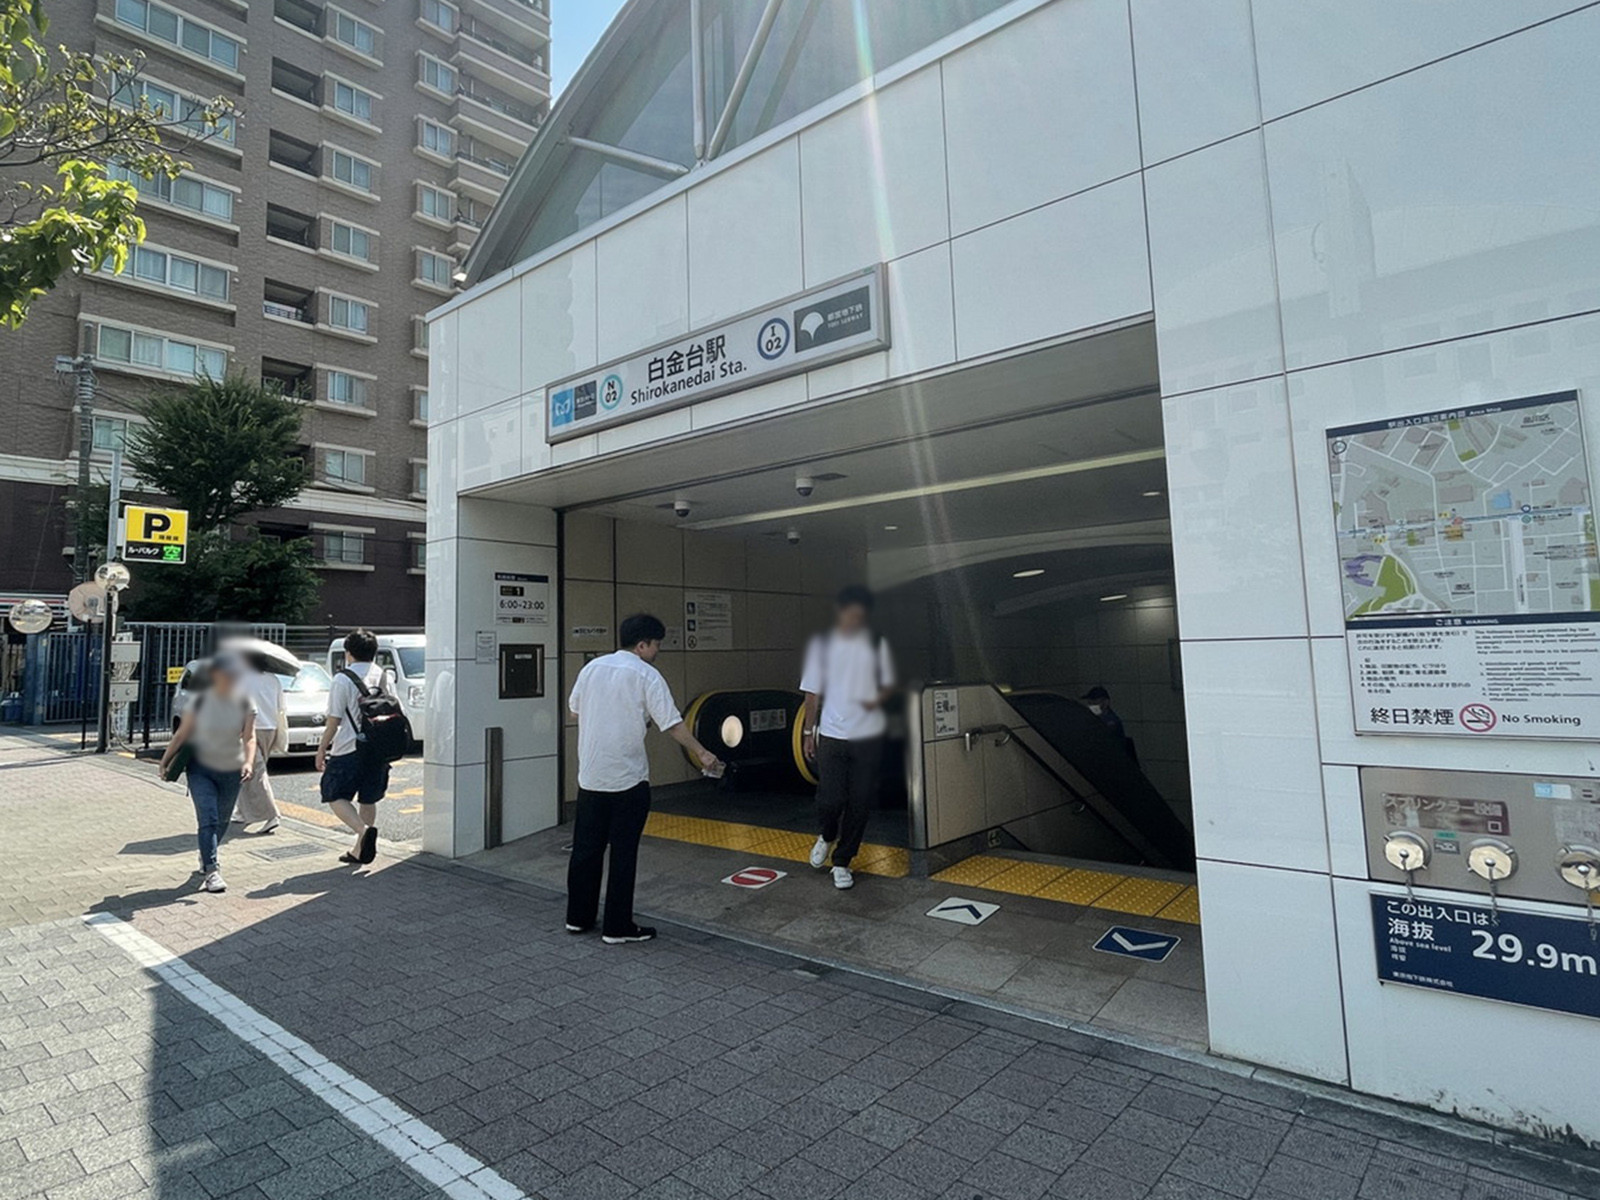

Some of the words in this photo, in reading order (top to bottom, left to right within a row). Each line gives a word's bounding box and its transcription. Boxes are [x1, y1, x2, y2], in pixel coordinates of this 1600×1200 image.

[770, 325, 776, 337] I
[765, 337, 781, 352] 02
[648, 334, 726, 383] 白金台駅
[607, 380, 615, 390] N
[630, 365, 715, 406] Shirokanedai
[720, 360, 747, 378] Sta.
[605, 390, 617, 403] 02
[143, 513, 171, 539] P
[1370, 707, 1454, 726] 終日禁煙
[1502, 714, 1520, 724] No
[1523, 714, 1581, 727] Smoking
[1387, 900, 1489, 926] この出入口は
[1388, 917, 1435, 941] 海抜
[1389, 937, 1413, 947] Above
[1415, 941, 1430, 949] sea
[1431, 943, 1452, 953] level
[1471, 929, 1598, 976] 29.9m
